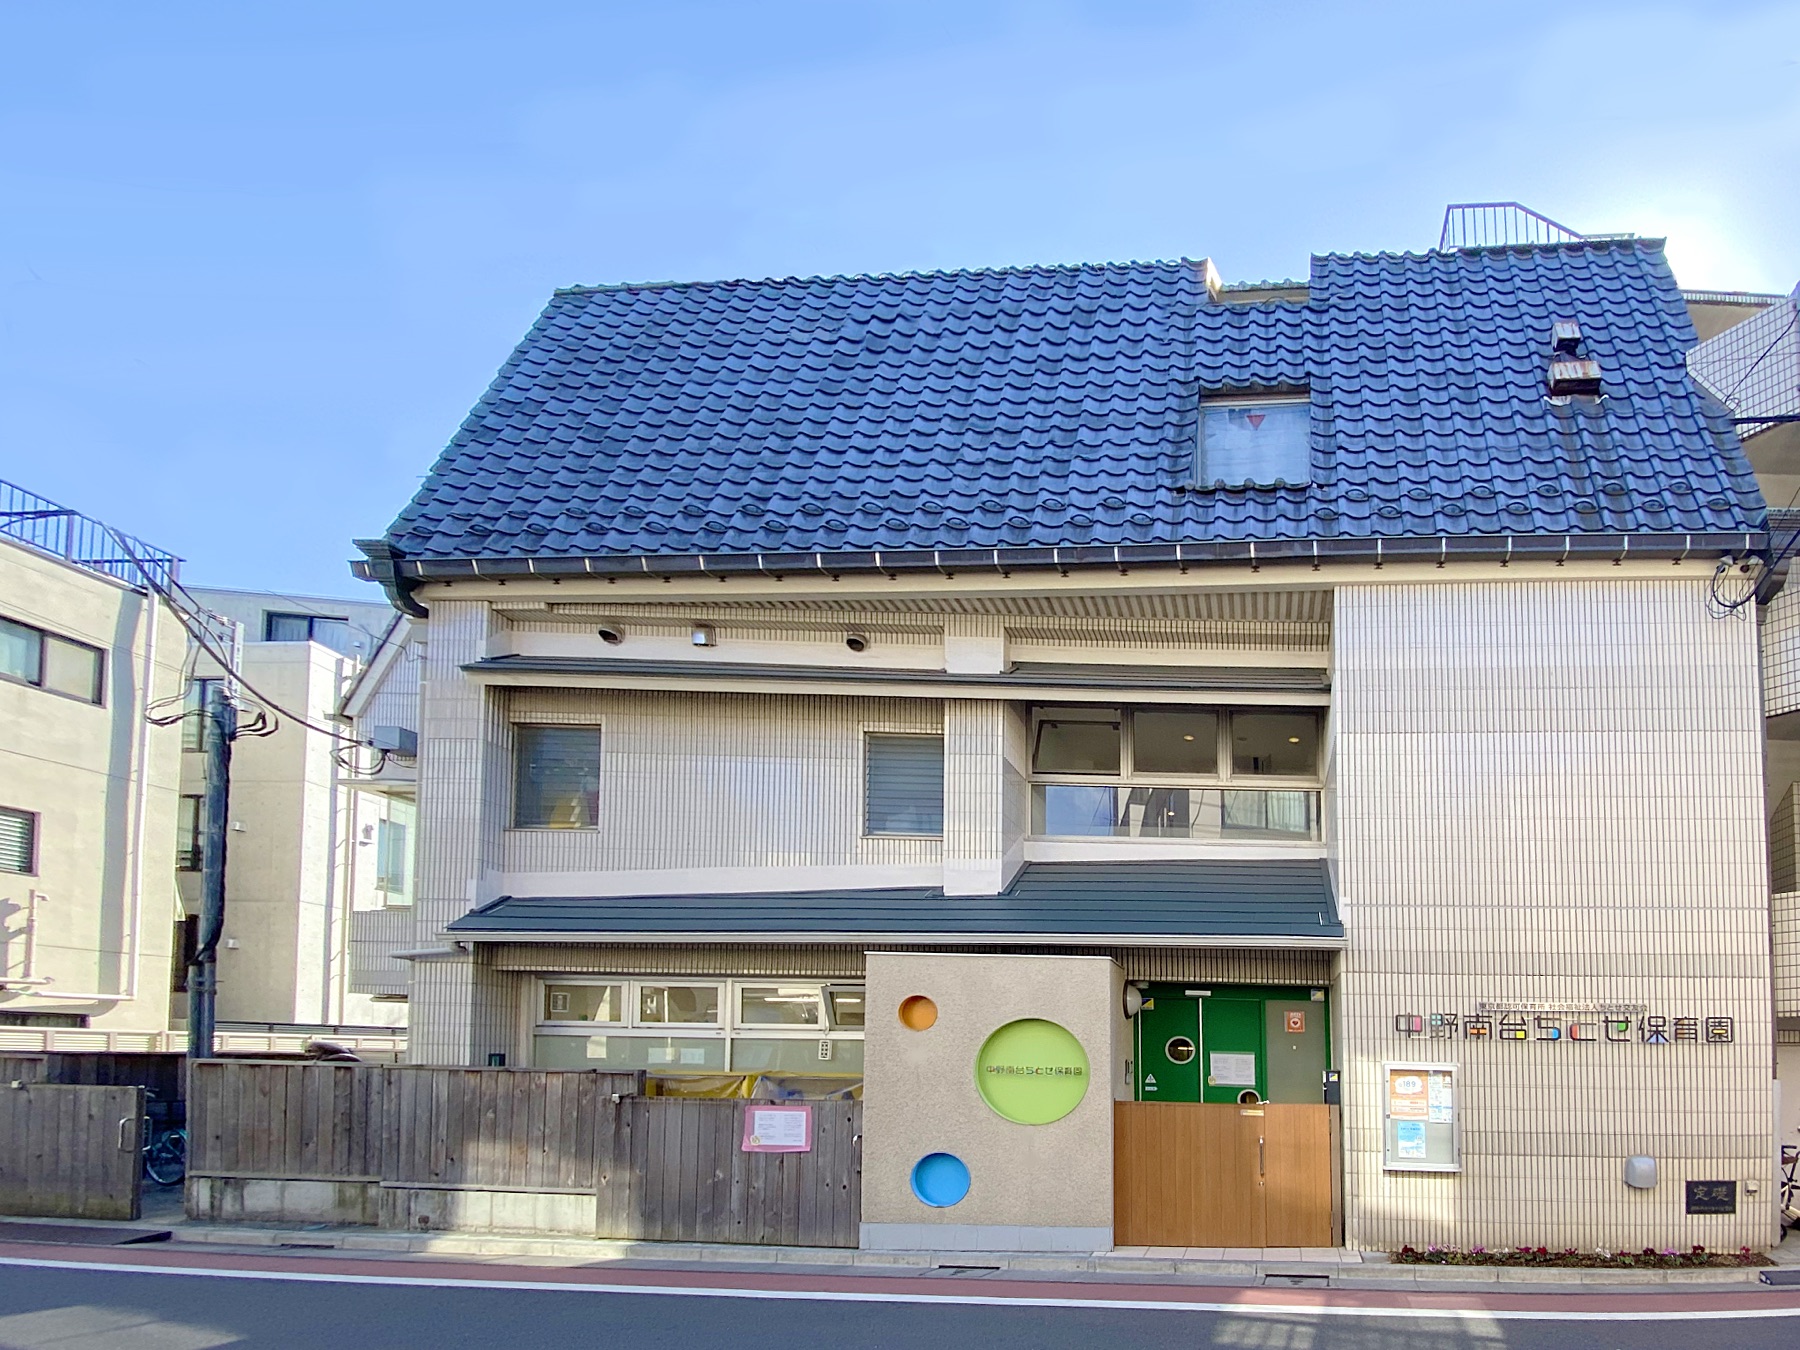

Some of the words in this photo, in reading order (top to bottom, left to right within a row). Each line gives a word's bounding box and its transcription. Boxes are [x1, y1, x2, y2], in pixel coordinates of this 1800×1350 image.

[1396, 1012, 1733, 1043] 中野南台ちとせ保育園
[986, 1065, 1082, 1076] 中野南台ちとせ保育園
[1693, 1185, 1730, 1201] 定礎
